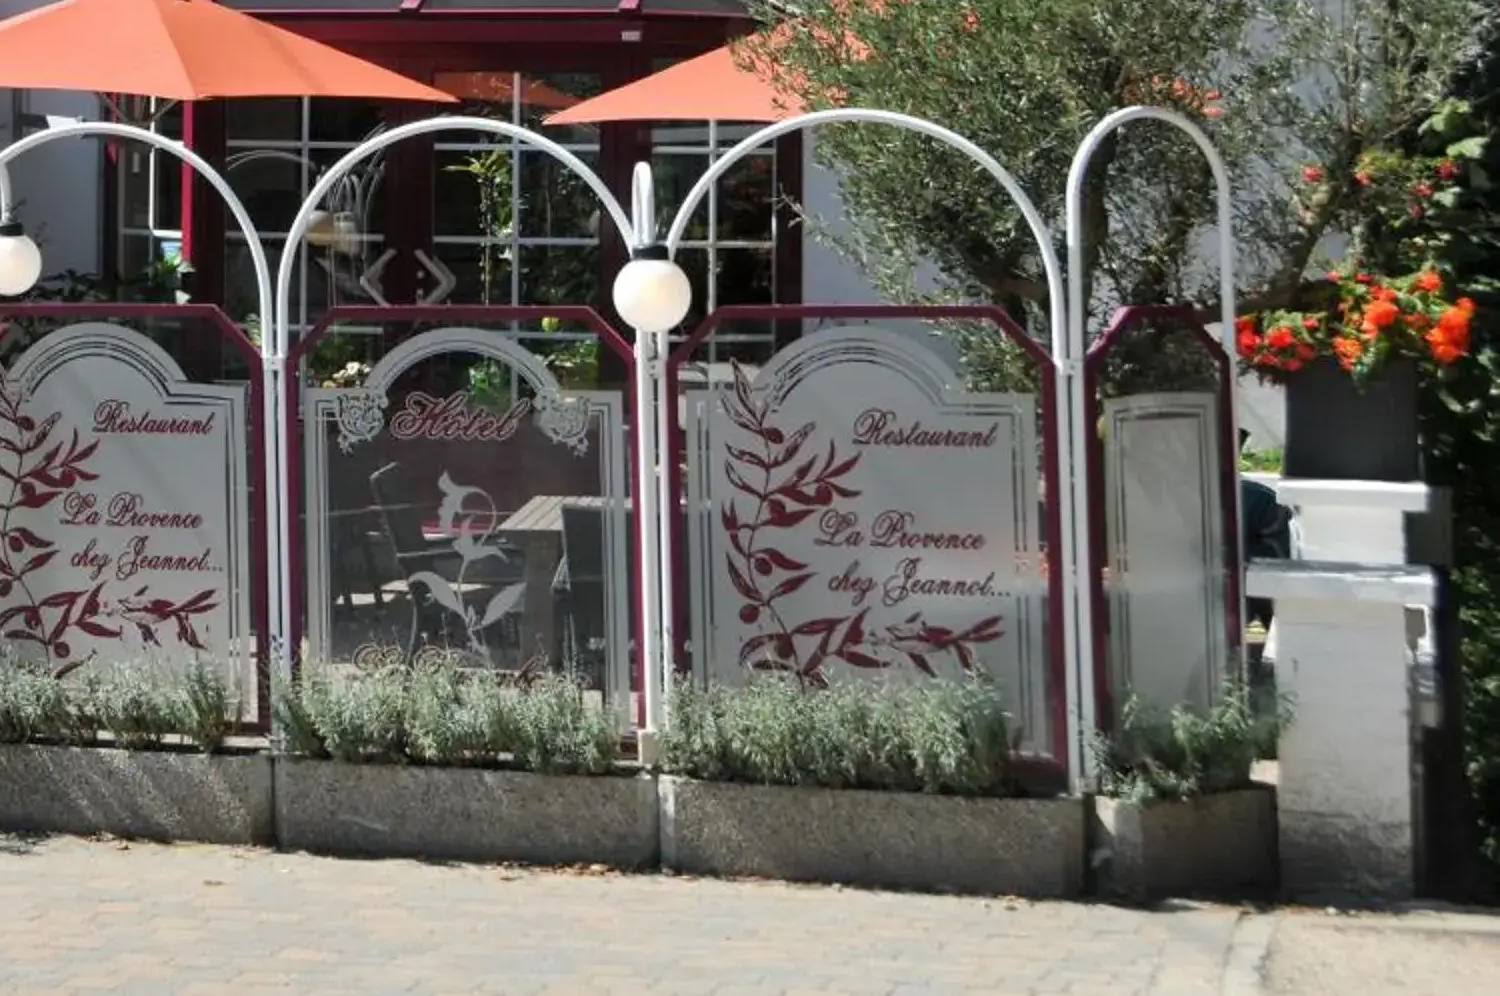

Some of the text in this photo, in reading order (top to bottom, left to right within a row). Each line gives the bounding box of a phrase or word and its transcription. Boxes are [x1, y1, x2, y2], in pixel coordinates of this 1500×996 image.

[91, 398, 216, 436] Restaurant
[389, 390, 532, 442] Hôtel
[852, 407, 999, 447] Restaurant
[59, 491, 204, 529] La Provence
[813, 508, 987, 550] La Provence
[70, 534, 224, 582] chez Jeannot...
[827, 556, 1012, 608] chez Jeannot...
